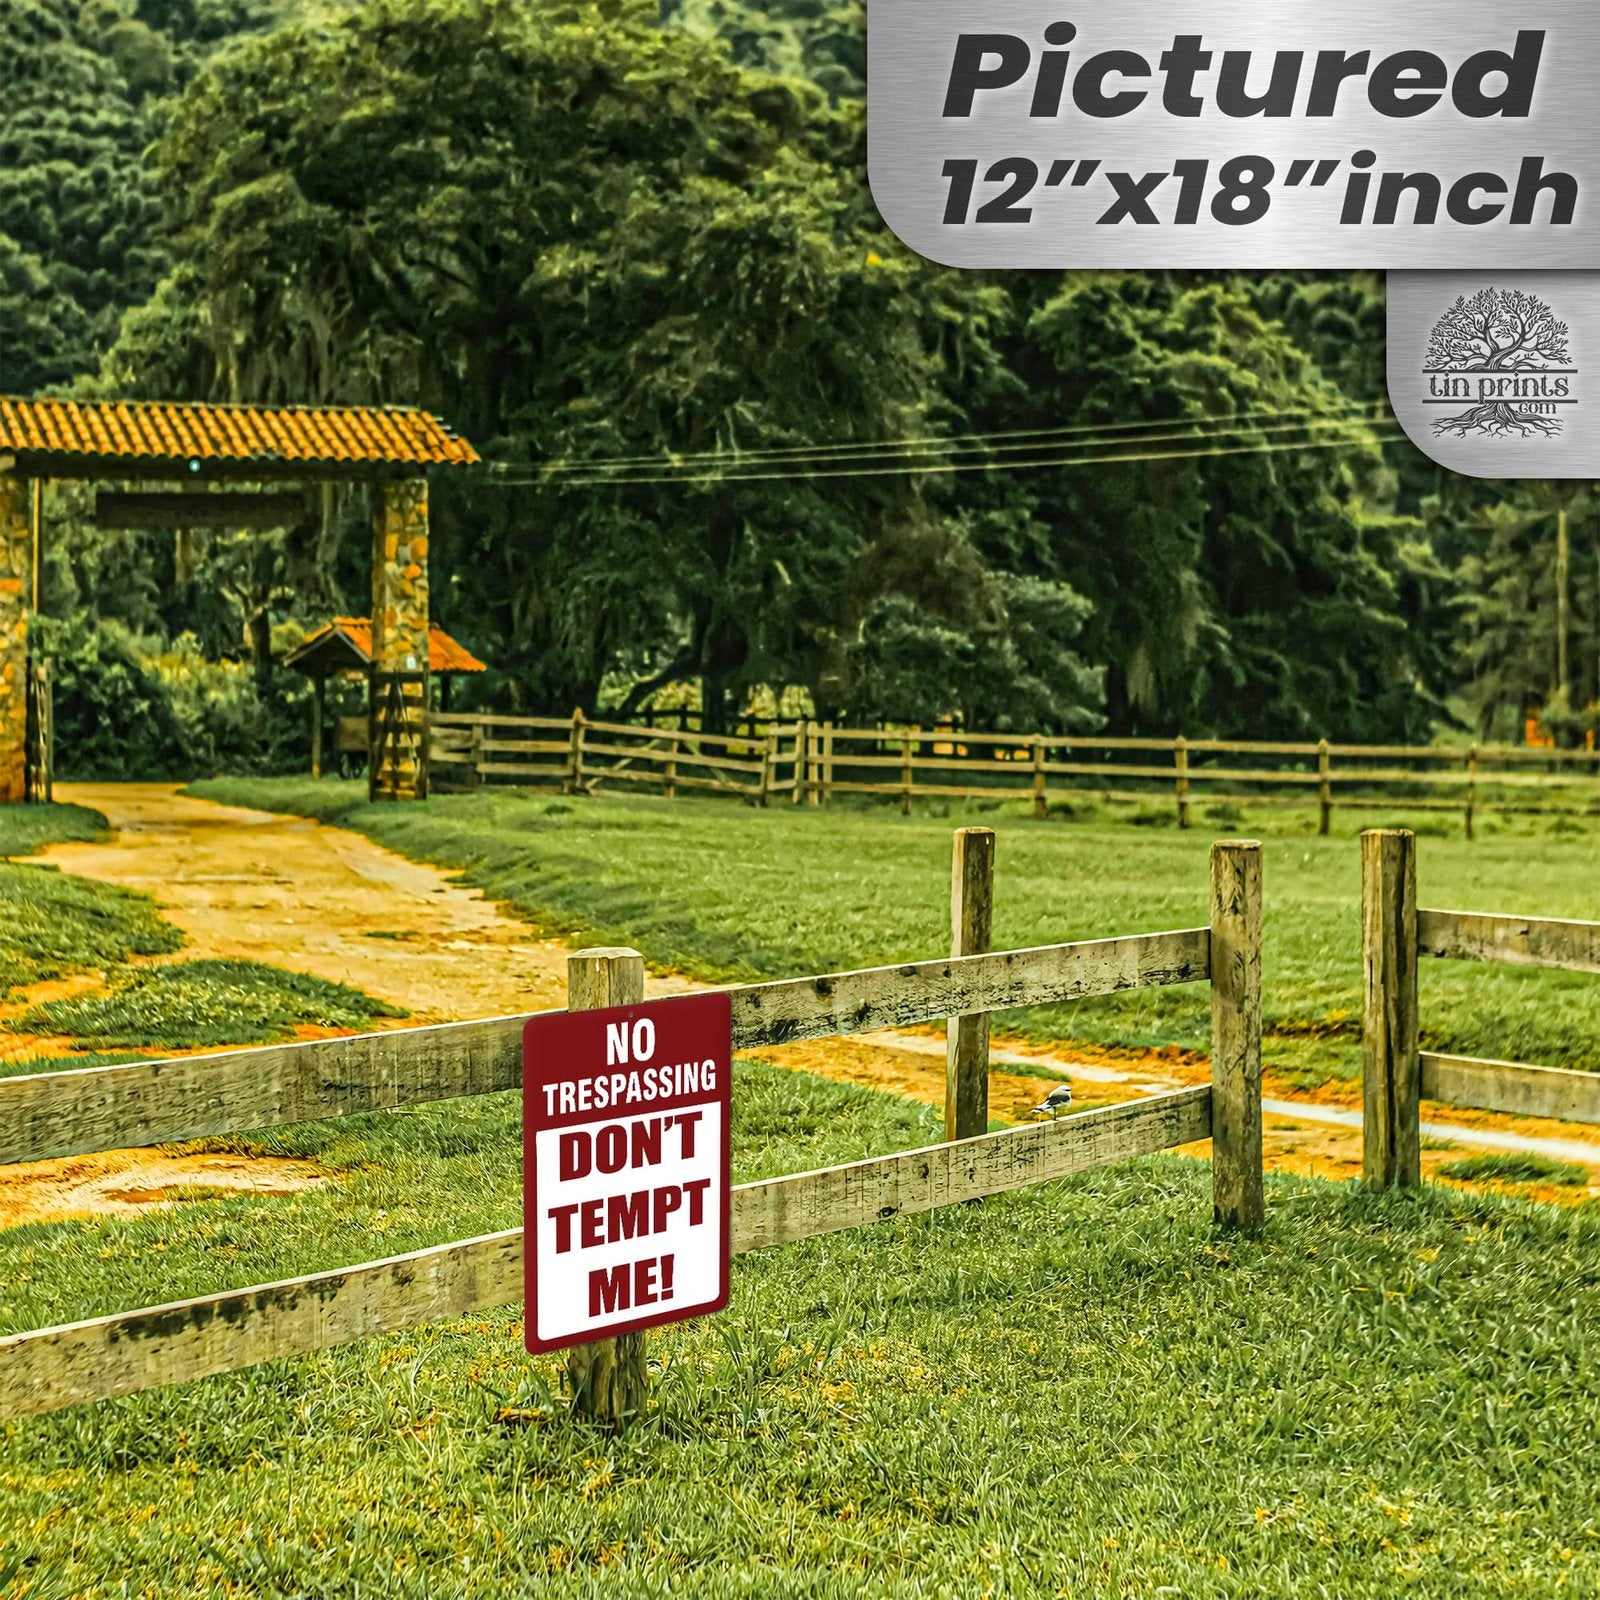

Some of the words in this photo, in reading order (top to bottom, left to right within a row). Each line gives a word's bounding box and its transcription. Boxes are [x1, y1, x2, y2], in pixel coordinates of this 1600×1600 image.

[606, 1018, 656, 1066] NO
[542, 1059, 717, 1117] TRESPASSING
[559, 1111, 703, 1182] DON'T
[548, 1178, 711, 1254] TEMPT
[588, 1253, 675, 1318] ME!
